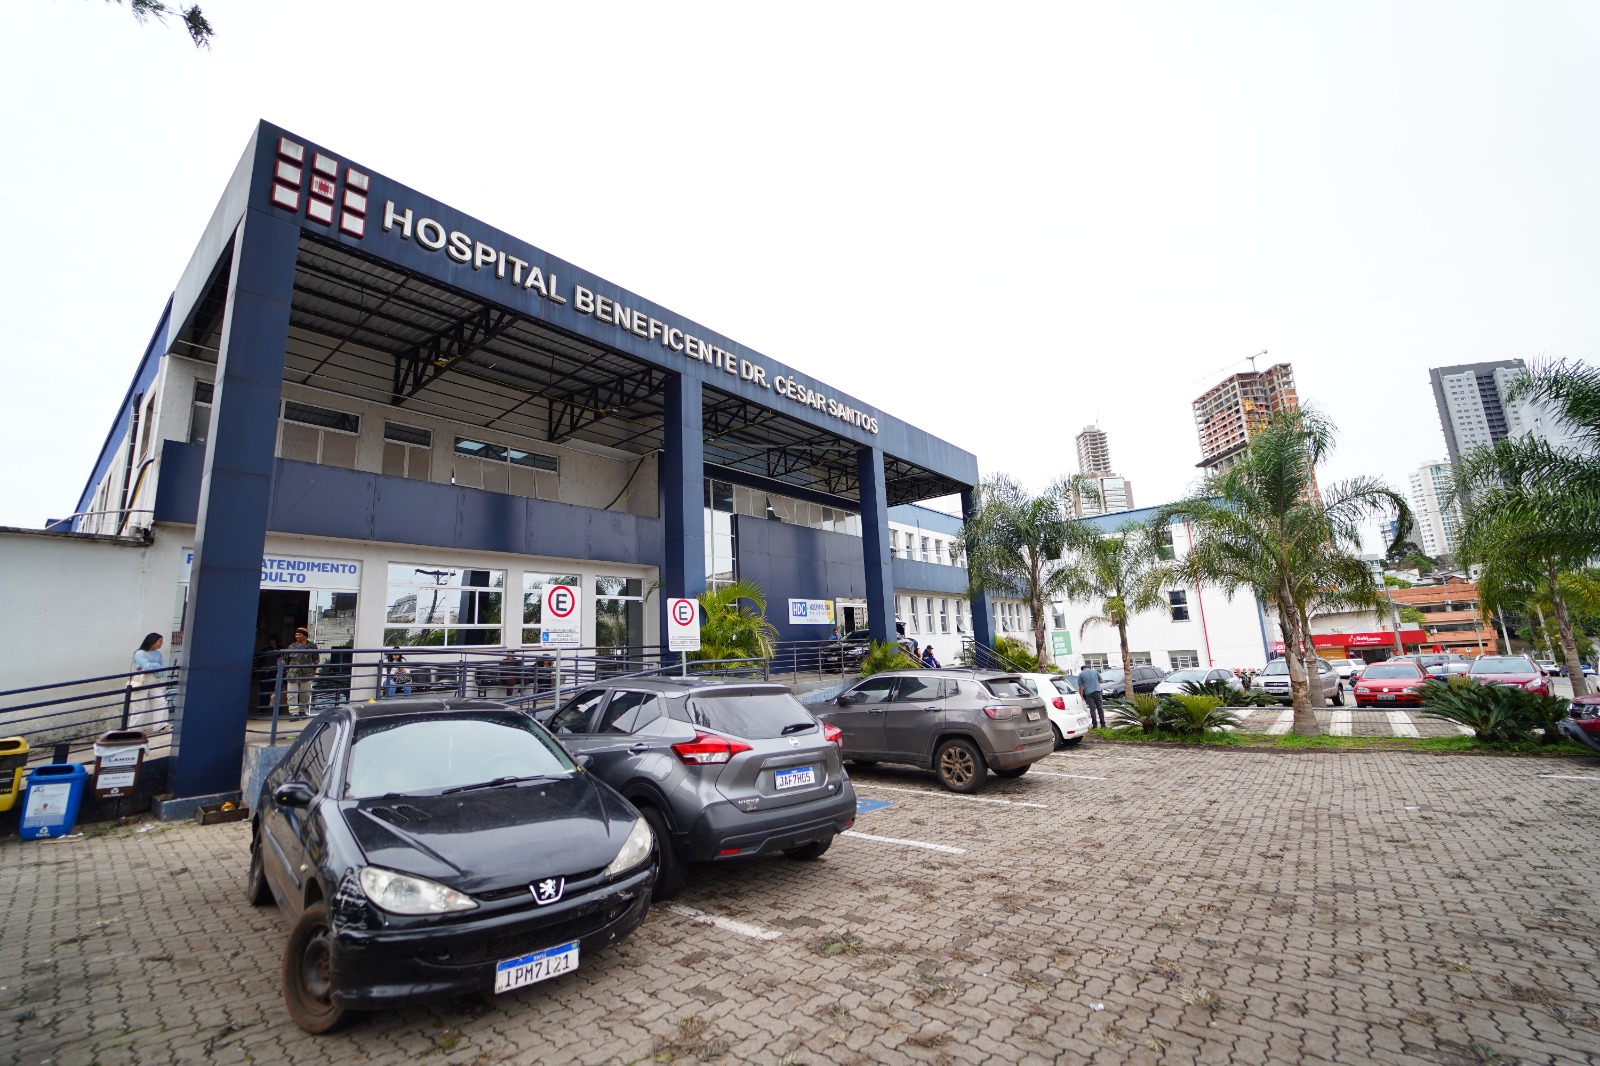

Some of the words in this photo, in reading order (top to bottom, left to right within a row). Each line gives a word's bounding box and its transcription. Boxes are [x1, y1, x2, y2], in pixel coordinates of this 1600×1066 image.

[382, 199, 567, 305] HOSPITAL
[574, 284, 738, 376] BENEFICENTE
[740, 358, 771, 389] DR.
[774, 375, 827, 410] CÉSAR
[827, 398, 879, 435] SANTOS
[262, 558, 357, 574] ATENDIMENTO
[261, 571, 306, 583] DULTO
[555, 593, 568, 612] E
[793, 602, 806, 616] HDC
[678, 605, 688, 621] E
[505, 954, 570, 988] IPM7I21
